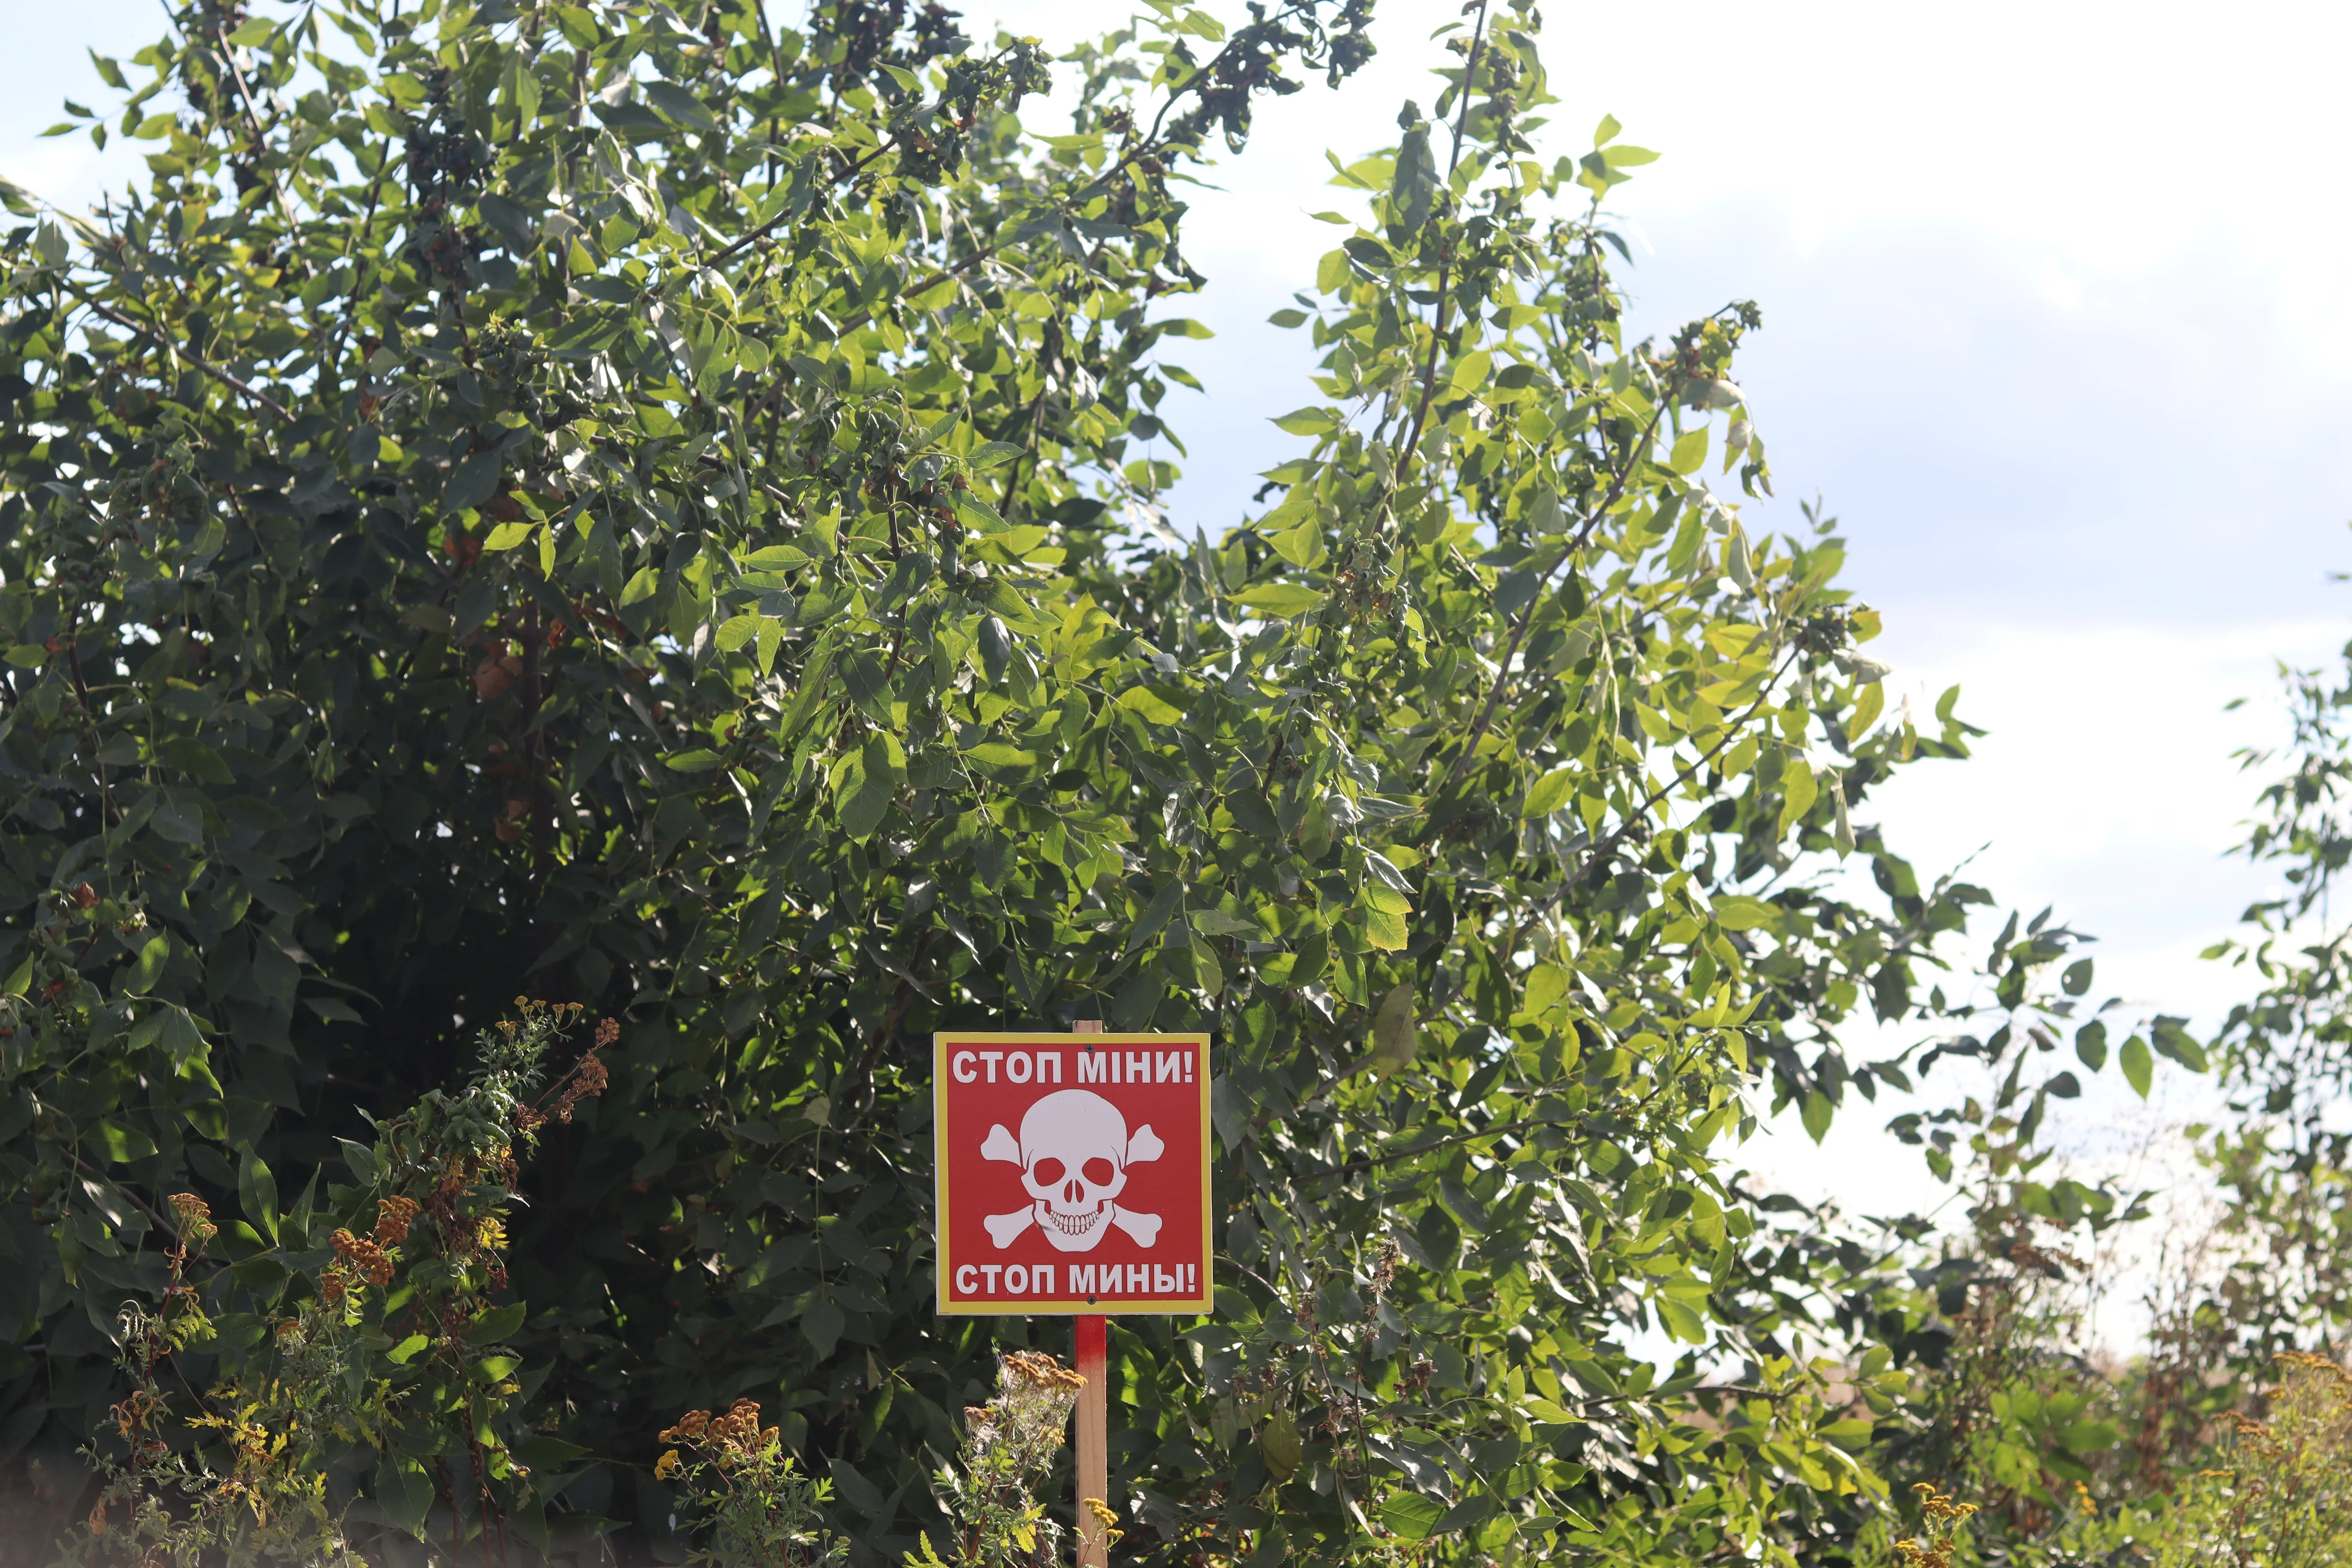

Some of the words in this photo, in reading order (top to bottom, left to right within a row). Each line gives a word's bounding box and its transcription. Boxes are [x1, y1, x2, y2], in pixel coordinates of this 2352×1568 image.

[953, 1051, 1062, 1083] СТОП
[1077, 1051, 1192, 1083] МІНИ!
[956, 1264, 1055, 1294] СТОП
[1069, 1263, 1195, 1294] МИНЫ!
